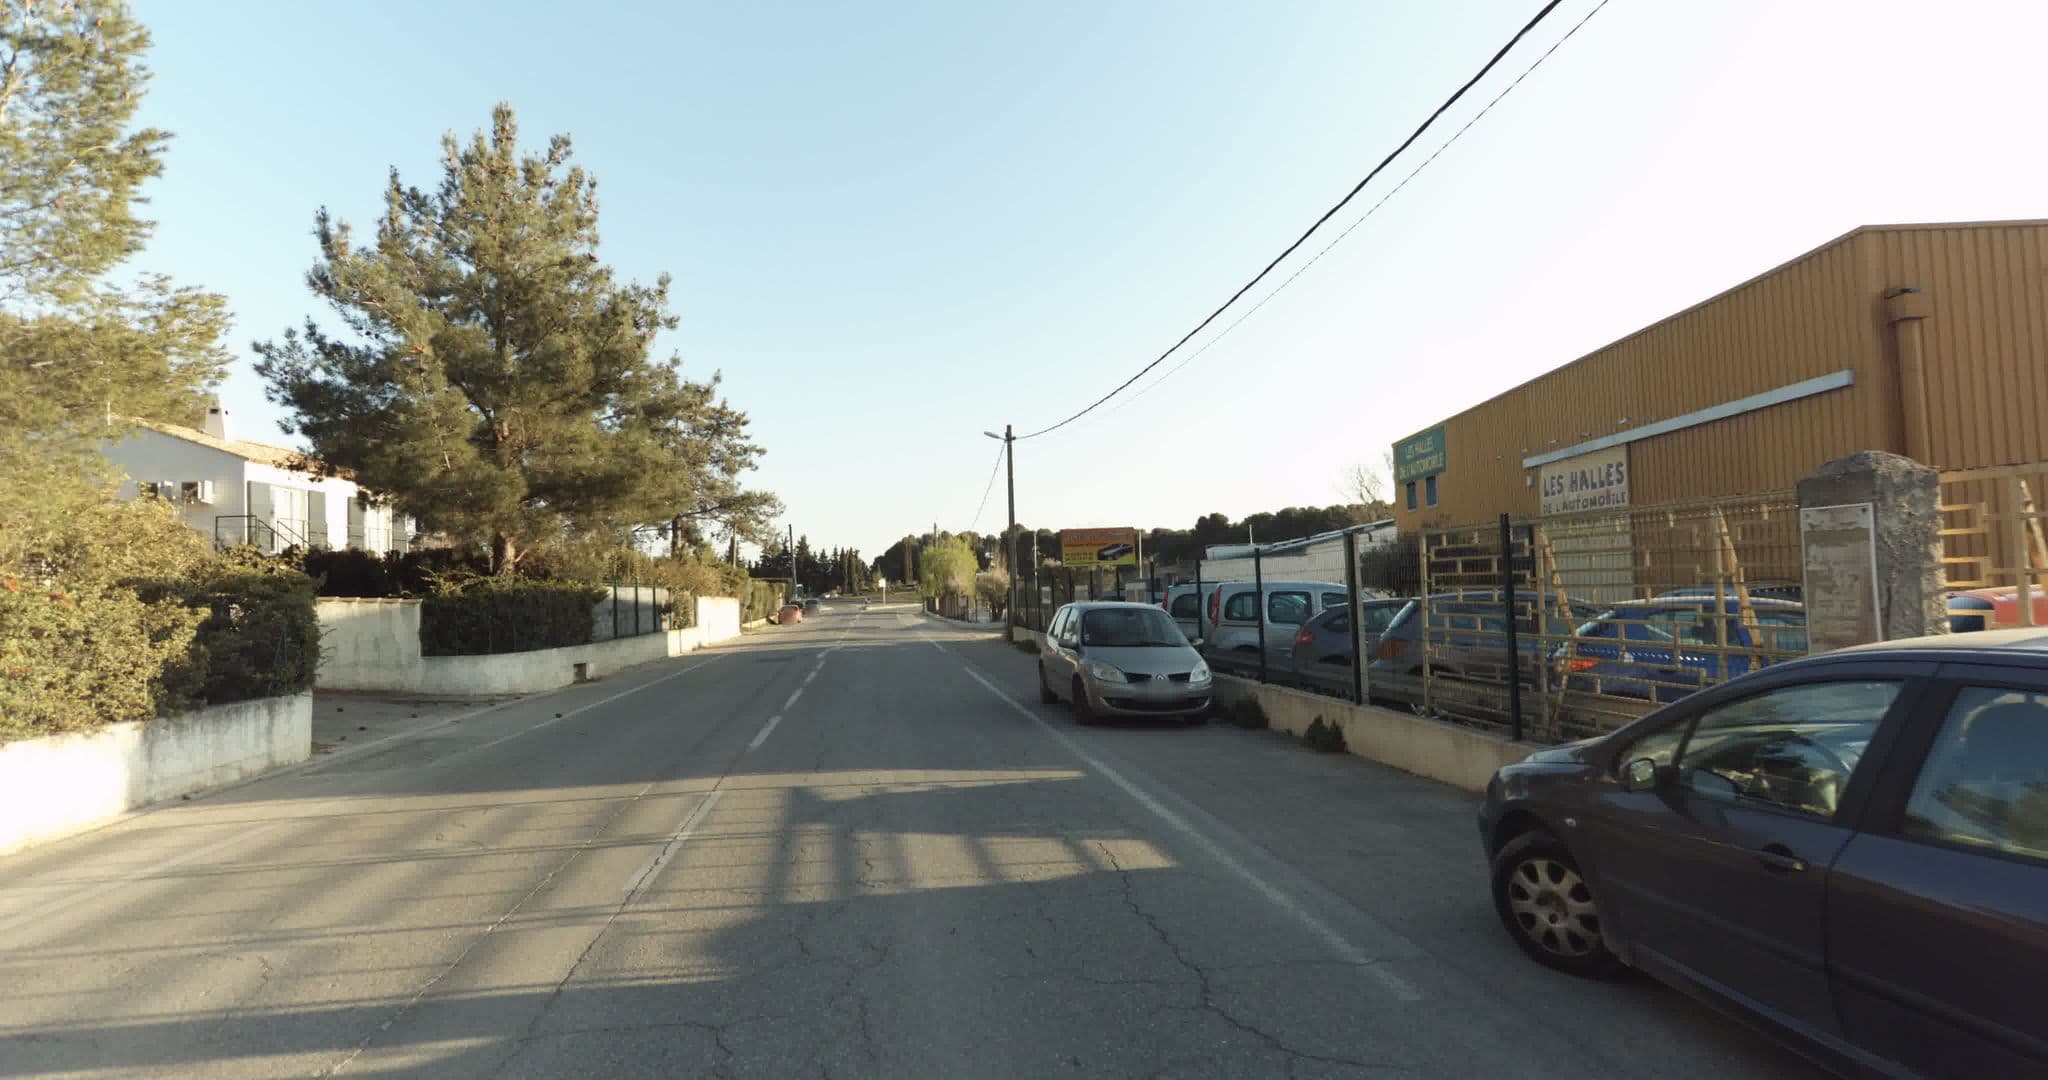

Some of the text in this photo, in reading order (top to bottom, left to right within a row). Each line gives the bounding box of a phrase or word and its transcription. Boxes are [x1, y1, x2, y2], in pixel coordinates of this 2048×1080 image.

[1543, 461, 1625, 498] LES HALLES
[1543, 502, 1552, 514] DE
